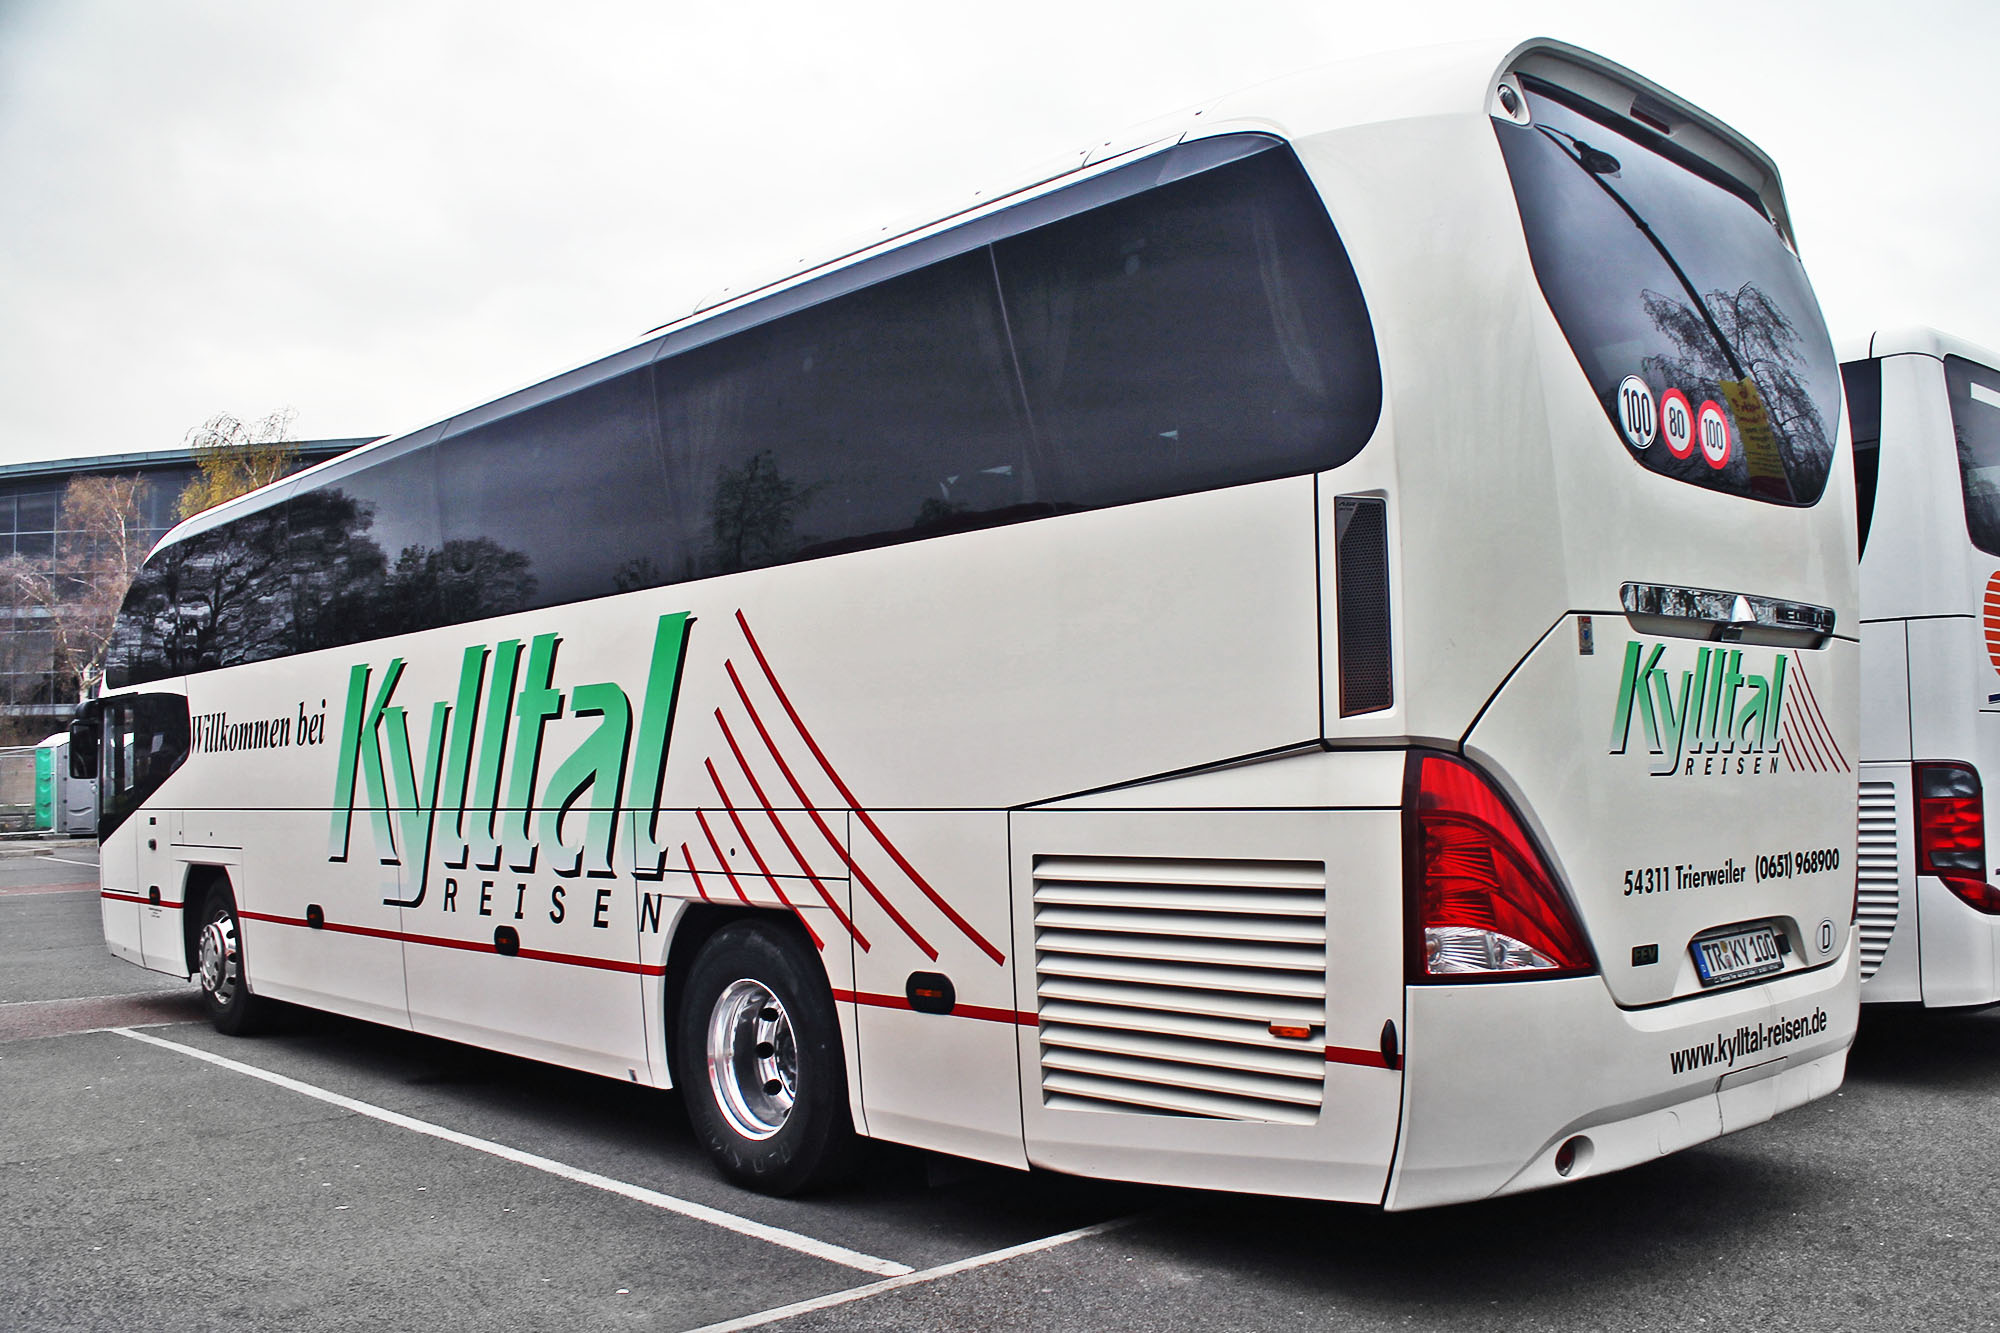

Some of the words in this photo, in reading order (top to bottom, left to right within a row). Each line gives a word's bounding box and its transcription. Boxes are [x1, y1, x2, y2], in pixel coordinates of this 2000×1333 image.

[1623, 387, 1652, 437] 100
[1669, 406, 1685, 440] 80
[1703, 418, 1723, 451] 100
[191, 711, 291, 754] Willkommen
[296, 698, 327, 746] bei
[1608, 640, 1788, 777] Kylltal
[328, 611, 698, 908] Kylltal
[1684, 756, 1779, 775] REISEN
[1623, 866, 1670, 896] 54311
[1675, 858, 1746, 890] Trierweiler
[1755, 851, 1792, 883] (0651)
[1795, 847, 1840, 875] 968900
[442, 877, 663, 934] REISEN
[1702, 943, 1727, 972] TR
[1728, 938, 1750, 967] KY
[1749, 933, 1777, 962] 100
[1670, 1006, 1827, 1075] www.kylltal-reisen.de
